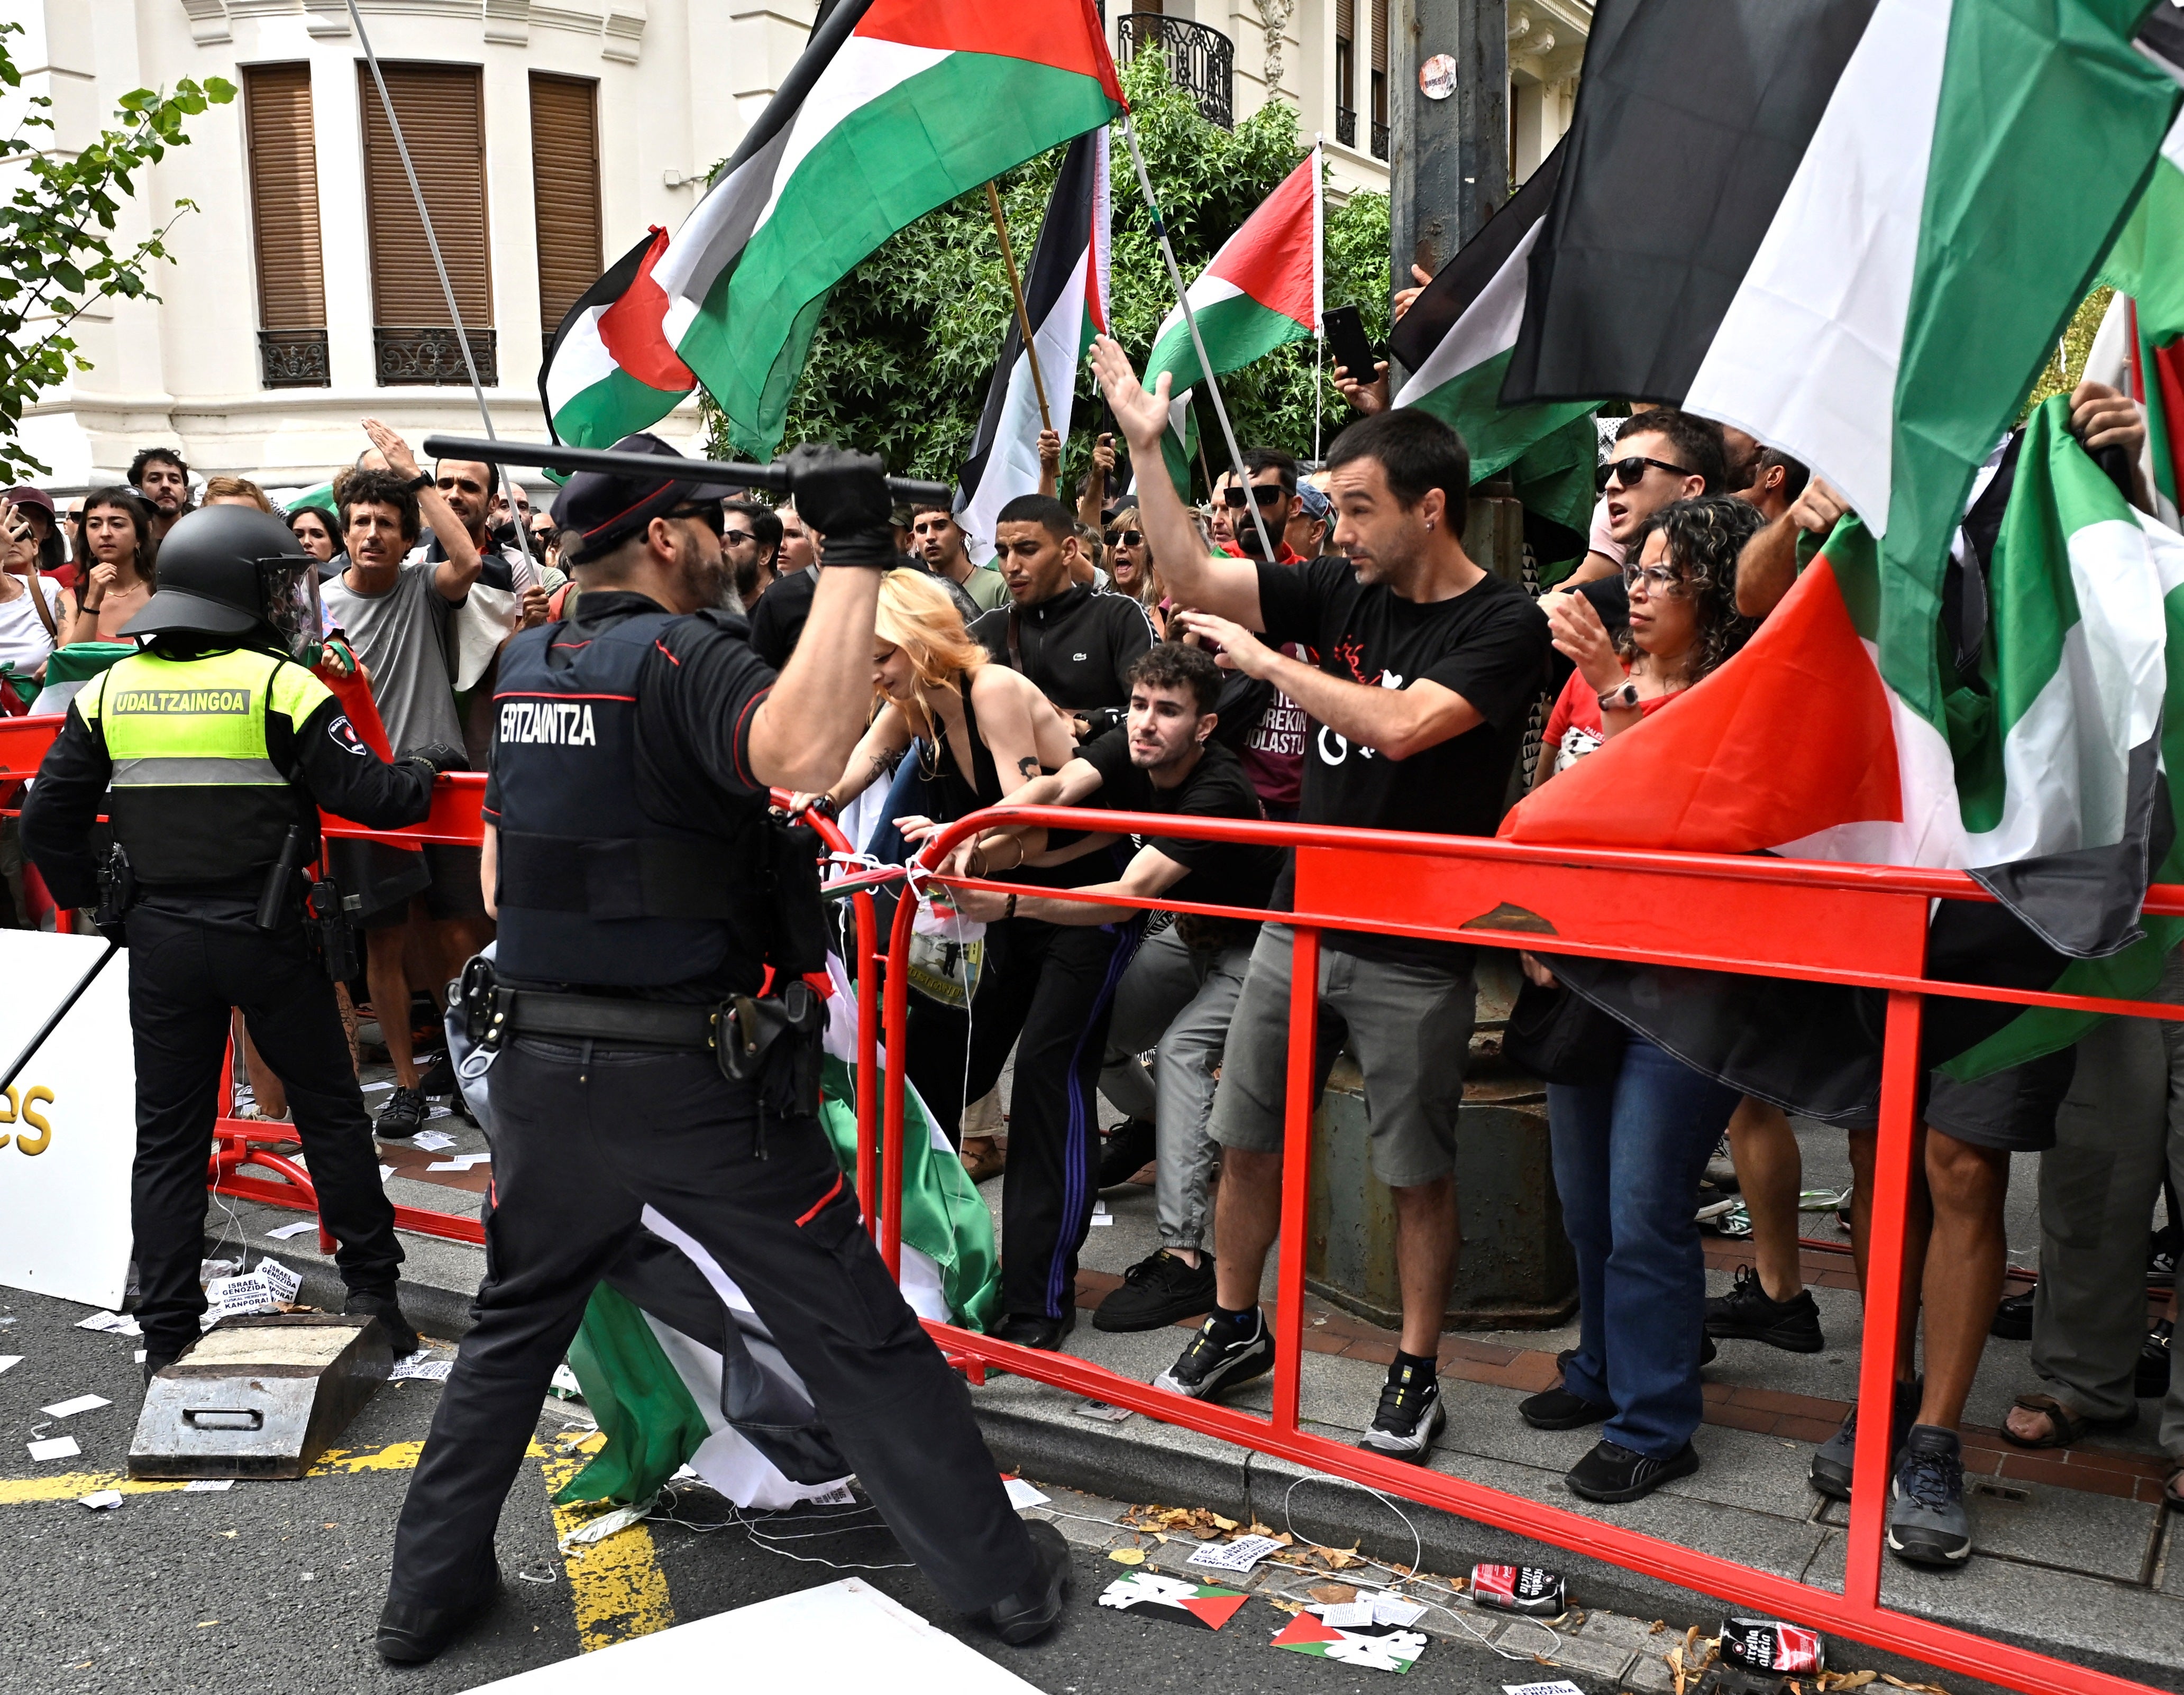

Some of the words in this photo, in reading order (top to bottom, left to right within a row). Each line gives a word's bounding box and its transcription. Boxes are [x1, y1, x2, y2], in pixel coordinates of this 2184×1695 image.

[116, 692, 244, 712] UDALTZAINGOA
[500, 703, 596, 746] ERTZAINTZA
[1244, 728, 1305, 755] JOLASTU
[262, 1267, 296, 1289] GENOZIDA
[269, 1264, 292, 1281] ISRAEL
[223, 1284, 266, 1295] GENOZIDA
[228, 1279, 259, 1289] ISRAEL
[225, 1297, 269, 1309] KANPORA!
[1222, 1539, 1254, 1554] ISRAEL
[1222, 1538, 1265, 1560] GENOZIDA
[1236, 1543, 1278, 1565] KANPORA!
[1520, 1567, 1533, 1593] alicia
[1531, 1568, 1545, 1596] strella
[1744, 1630, 1759, 1665] strella
[1758, 1634, 1771, 1667] alicia
